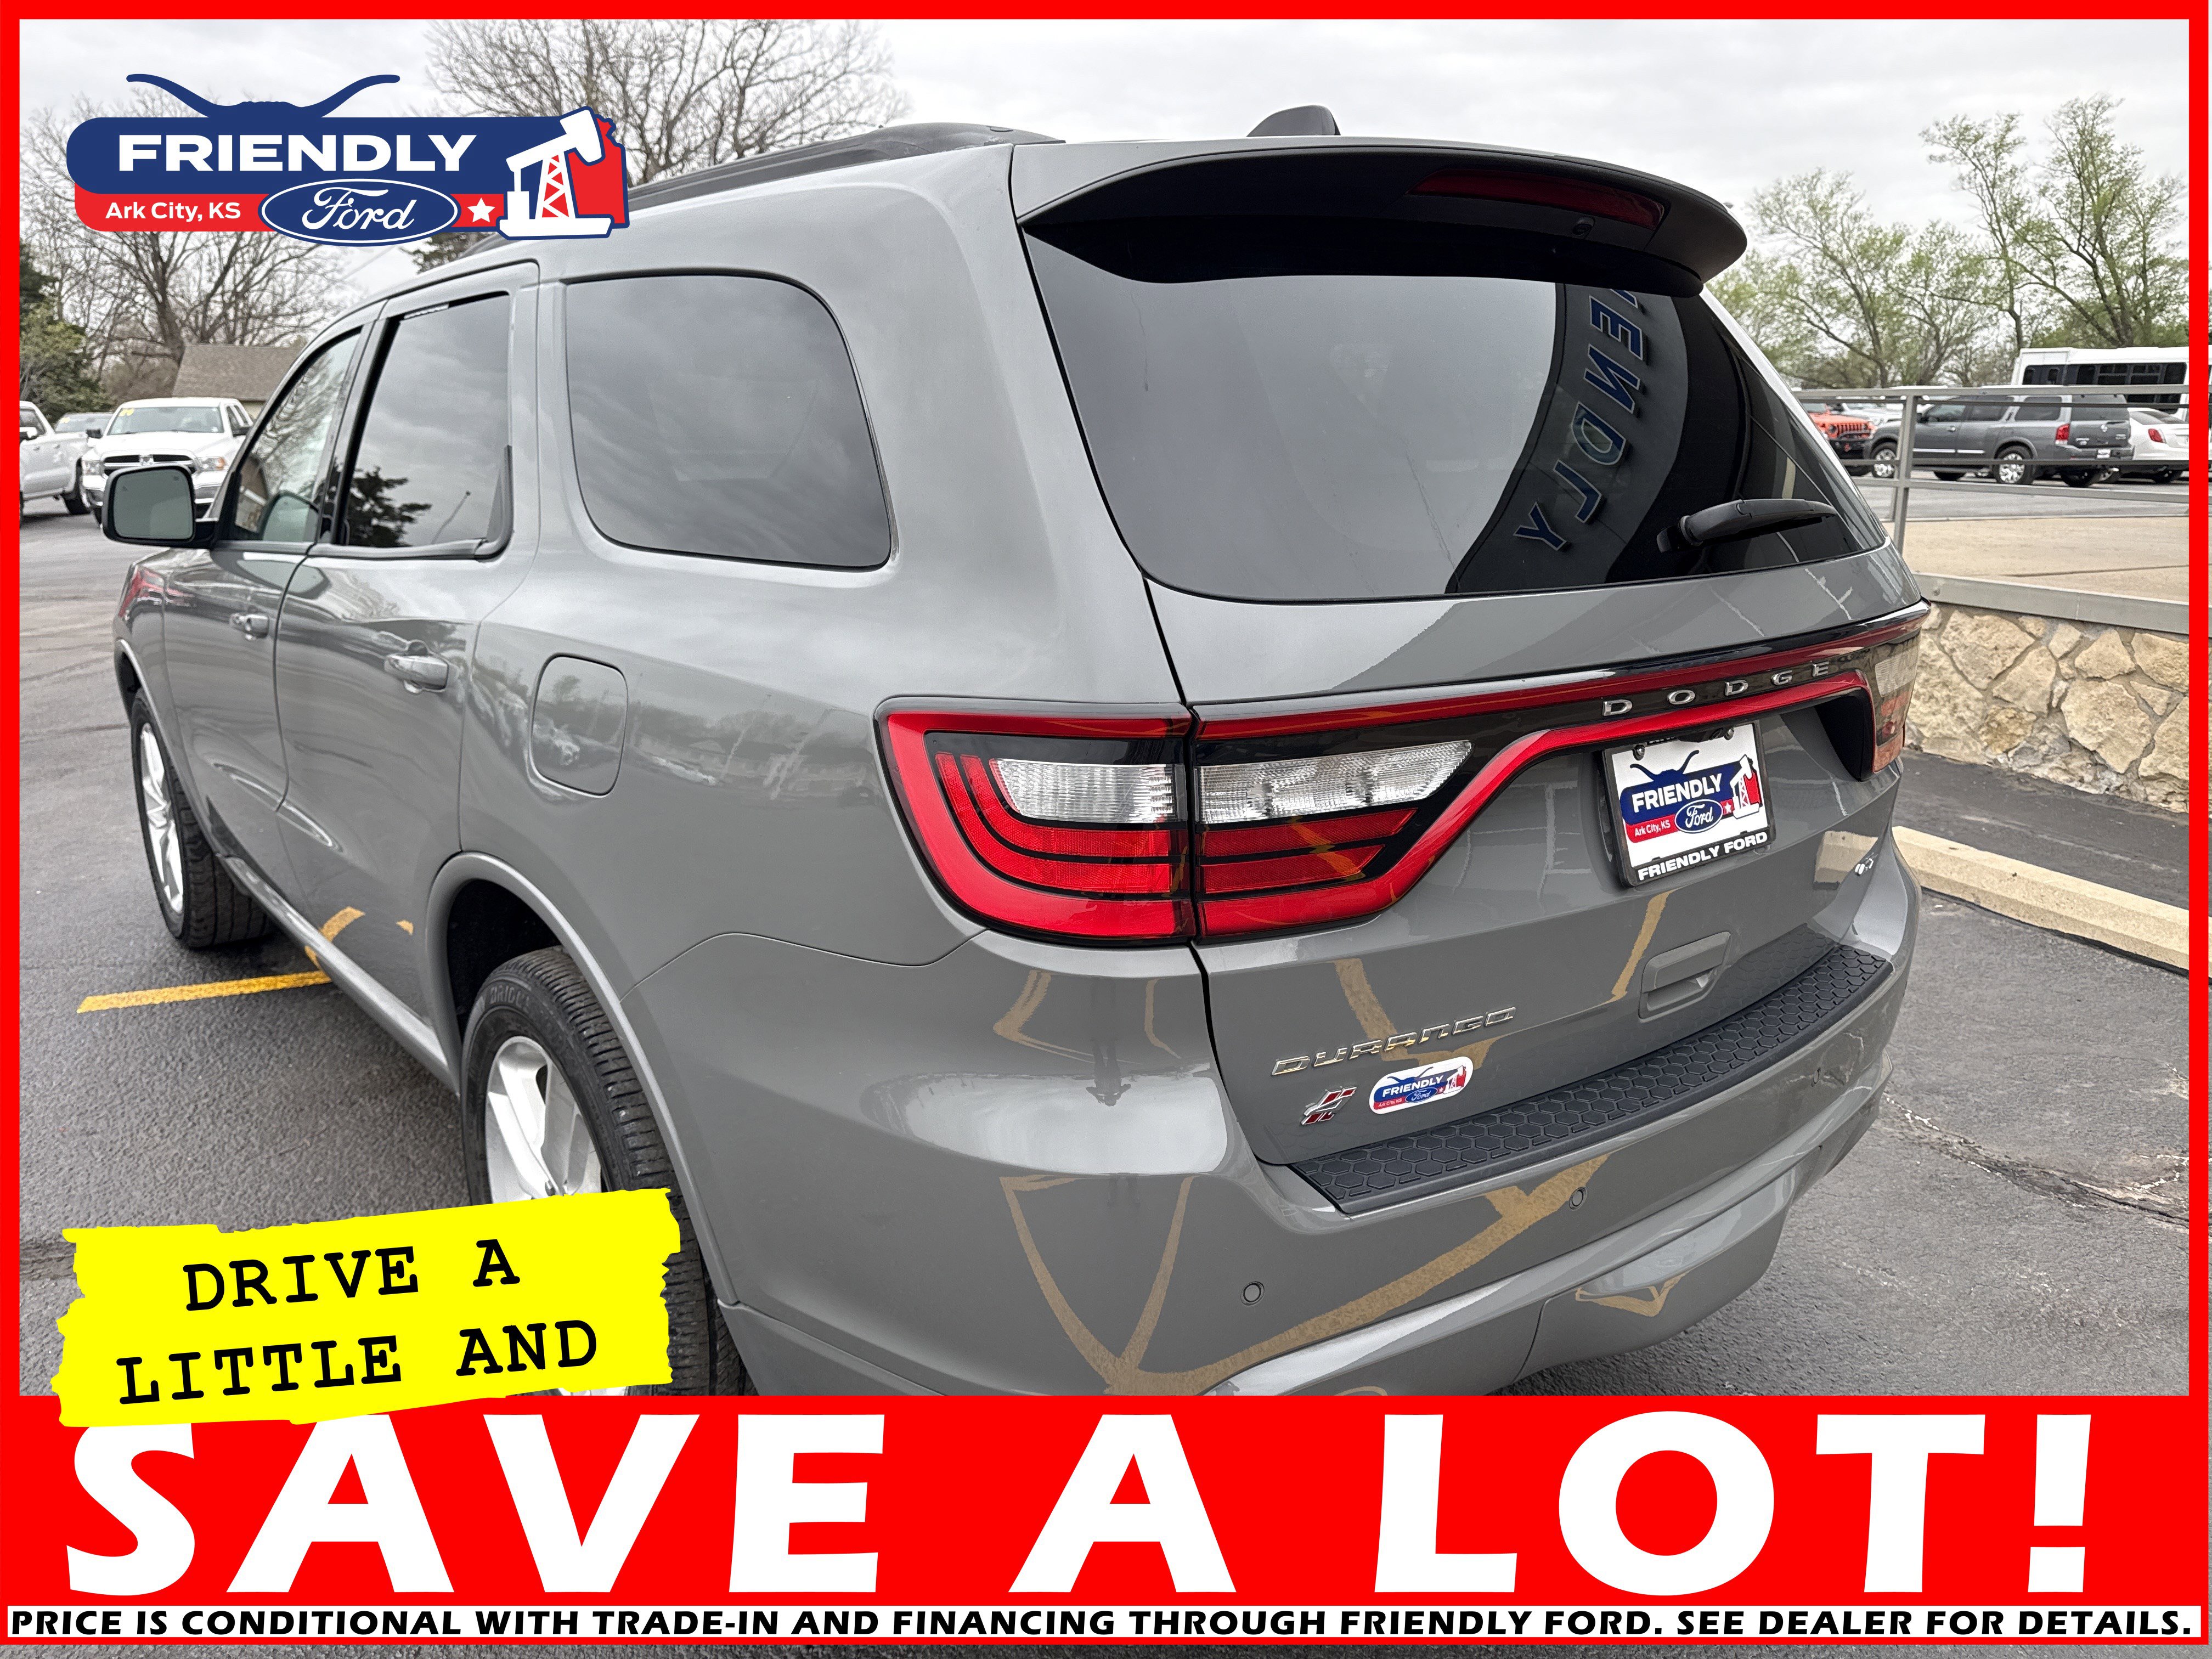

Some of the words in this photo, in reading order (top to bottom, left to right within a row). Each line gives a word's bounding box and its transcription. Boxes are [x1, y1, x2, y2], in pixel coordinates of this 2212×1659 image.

[1602, 661, 1830, 716] DODGE
[1632, 773, 1722, 813] FRIENDLY
[1634, 826, 1646, 837] Ark
[1646, 821, 1661, 834] City,
[1661, 819, 1671, 830] KS
[1685, 803, 1714, 829] Ford
[1638, 845, 1720, 881] FRIENDLY
[1724, 831, 1768, 854] FORD
[1271, 1006, 1517, 1076] DURANGO
[1382, 1074, 1444, 1098] FRIENDLY
[1411, 1088, 1432, 1102] Ford
